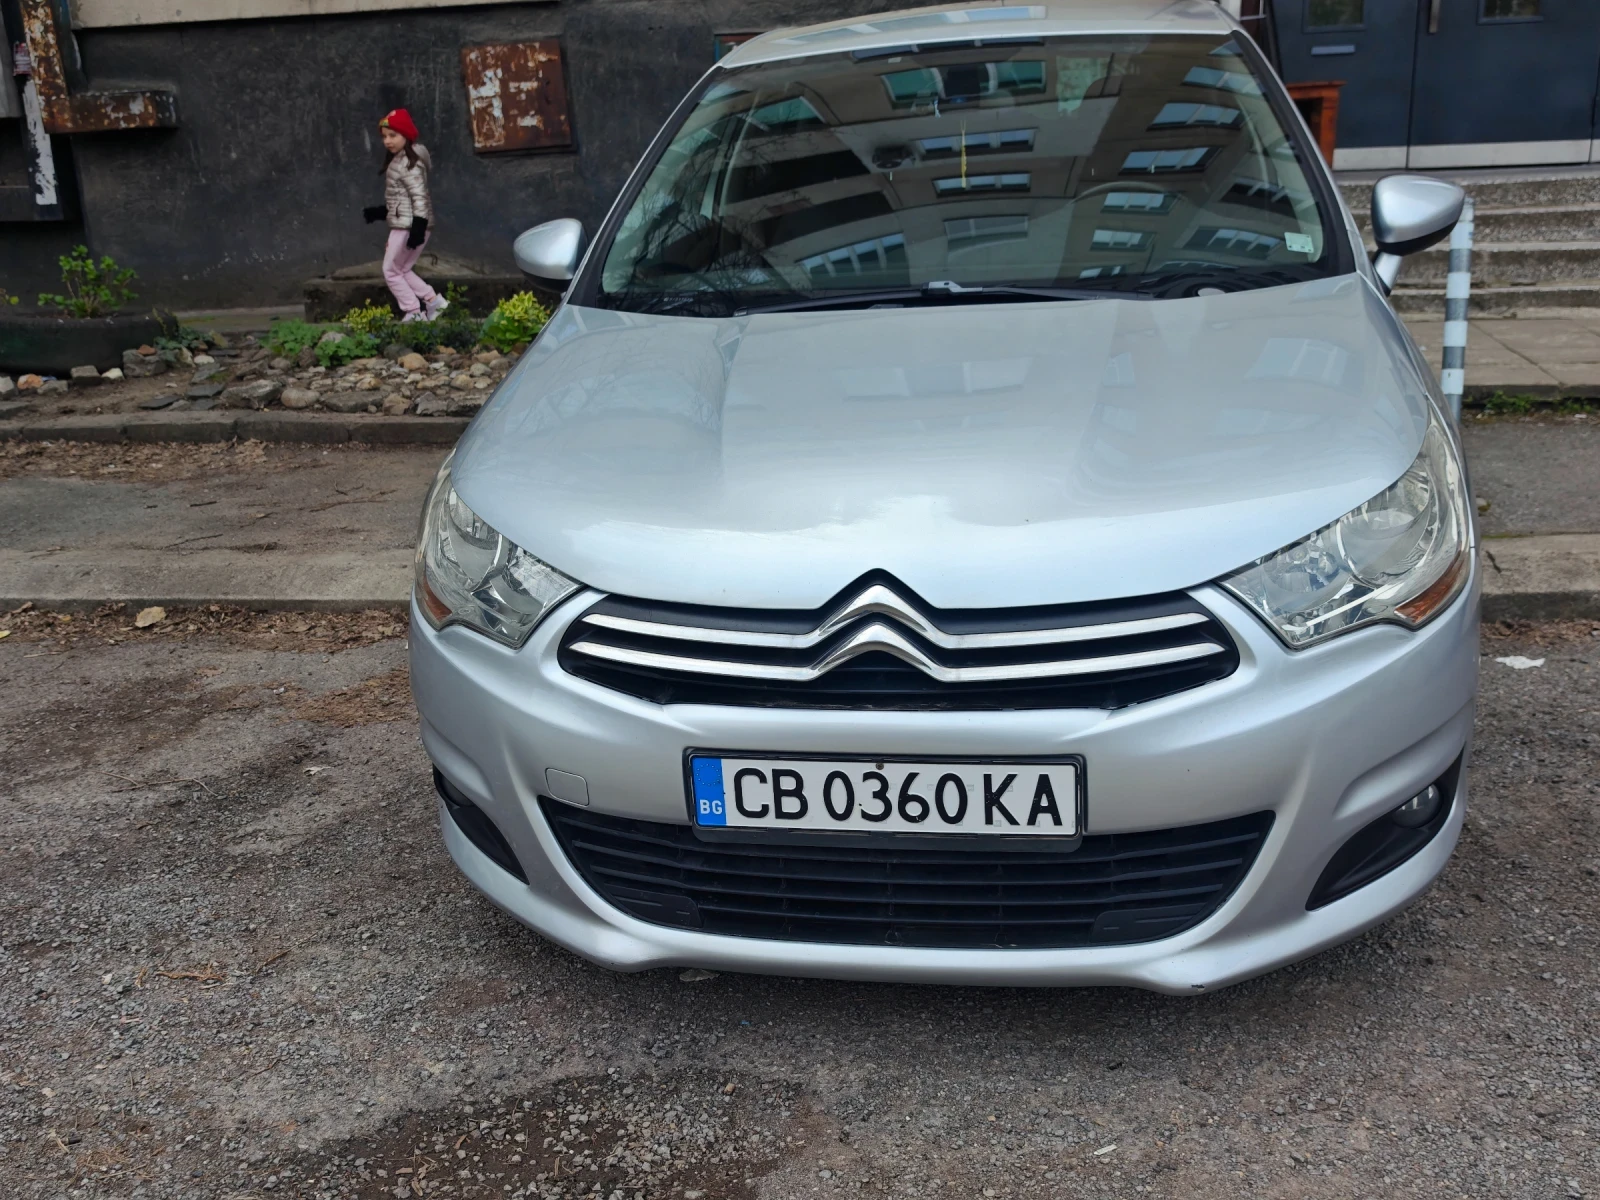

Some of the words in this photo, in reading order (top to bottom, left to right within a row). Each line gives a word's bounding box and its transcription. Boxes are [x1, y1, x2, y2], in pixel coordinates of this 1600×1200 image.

[700, 799, 722, 815] BG
[733, 767, 808, 820] CB
[823, 770, 968, 825] 0360
[984, 773, 1062, 826] KA
